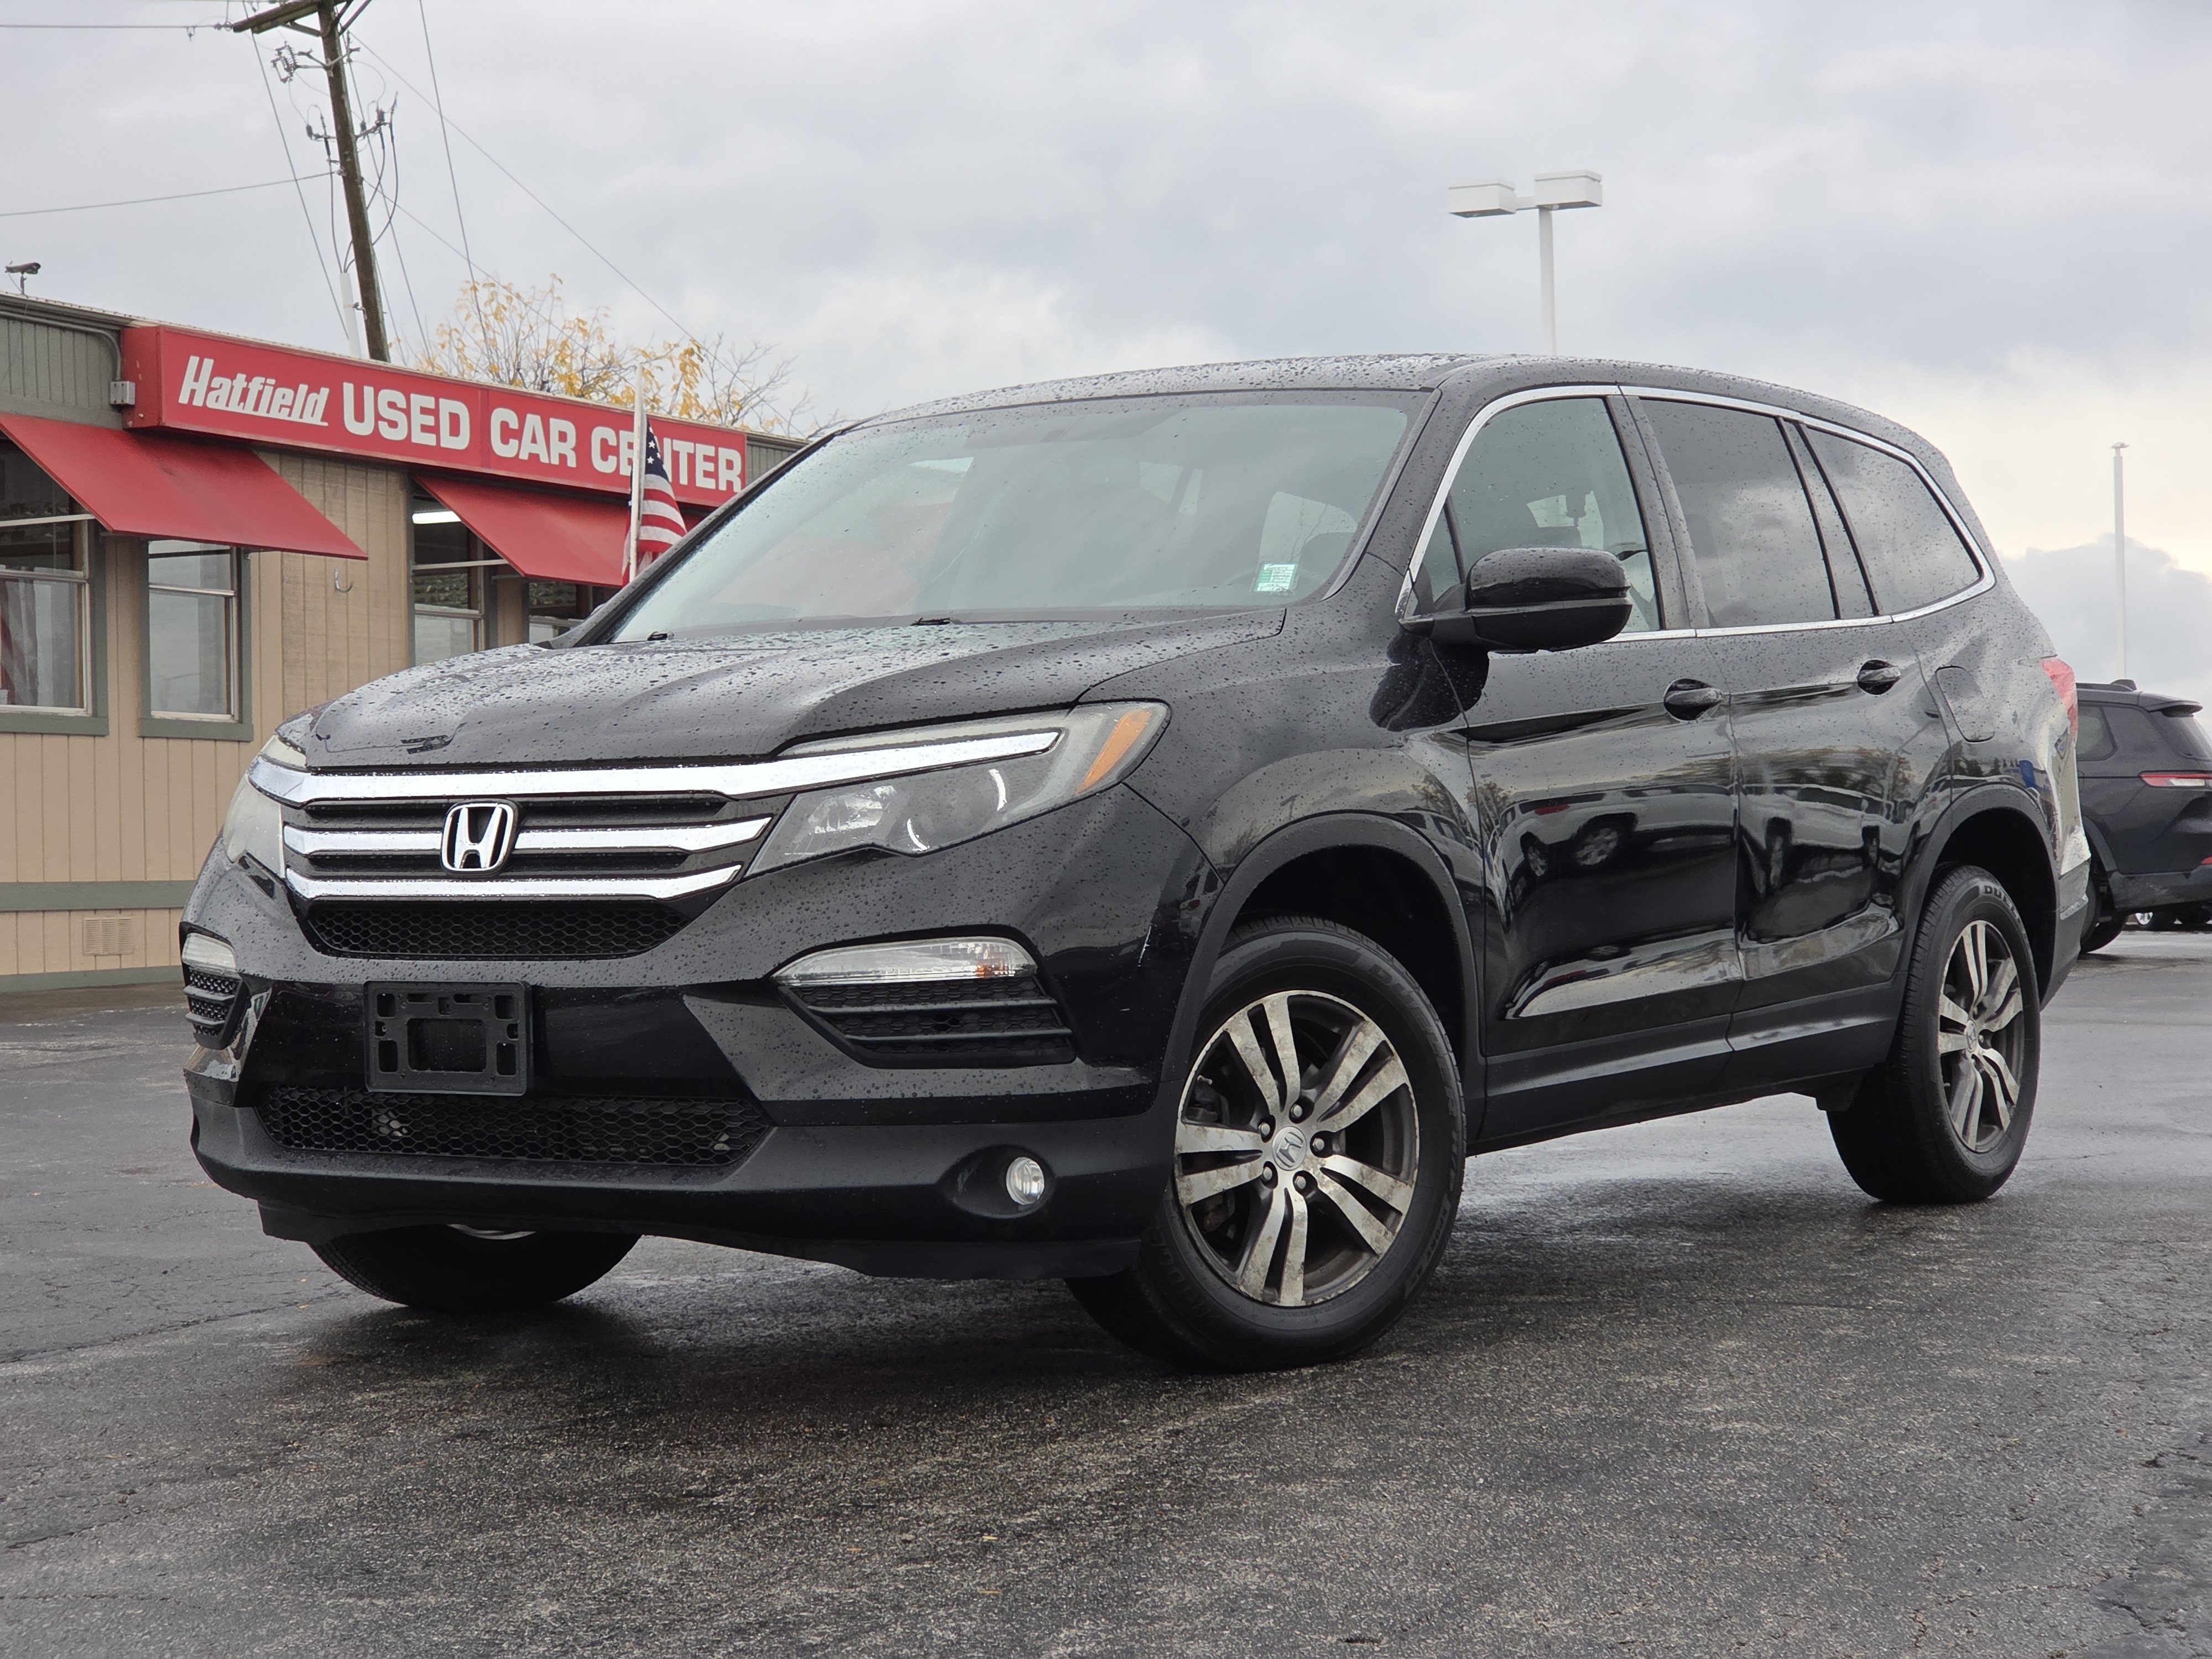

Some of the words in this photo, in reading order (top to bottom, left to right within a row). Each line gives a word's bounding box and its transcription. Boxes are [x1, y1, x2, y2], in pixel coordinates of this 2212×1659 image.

[178, 355, 329, 426] Hatfield
[343, 382, 471, 448] USED
[490, 407, 577, 468] CAR
